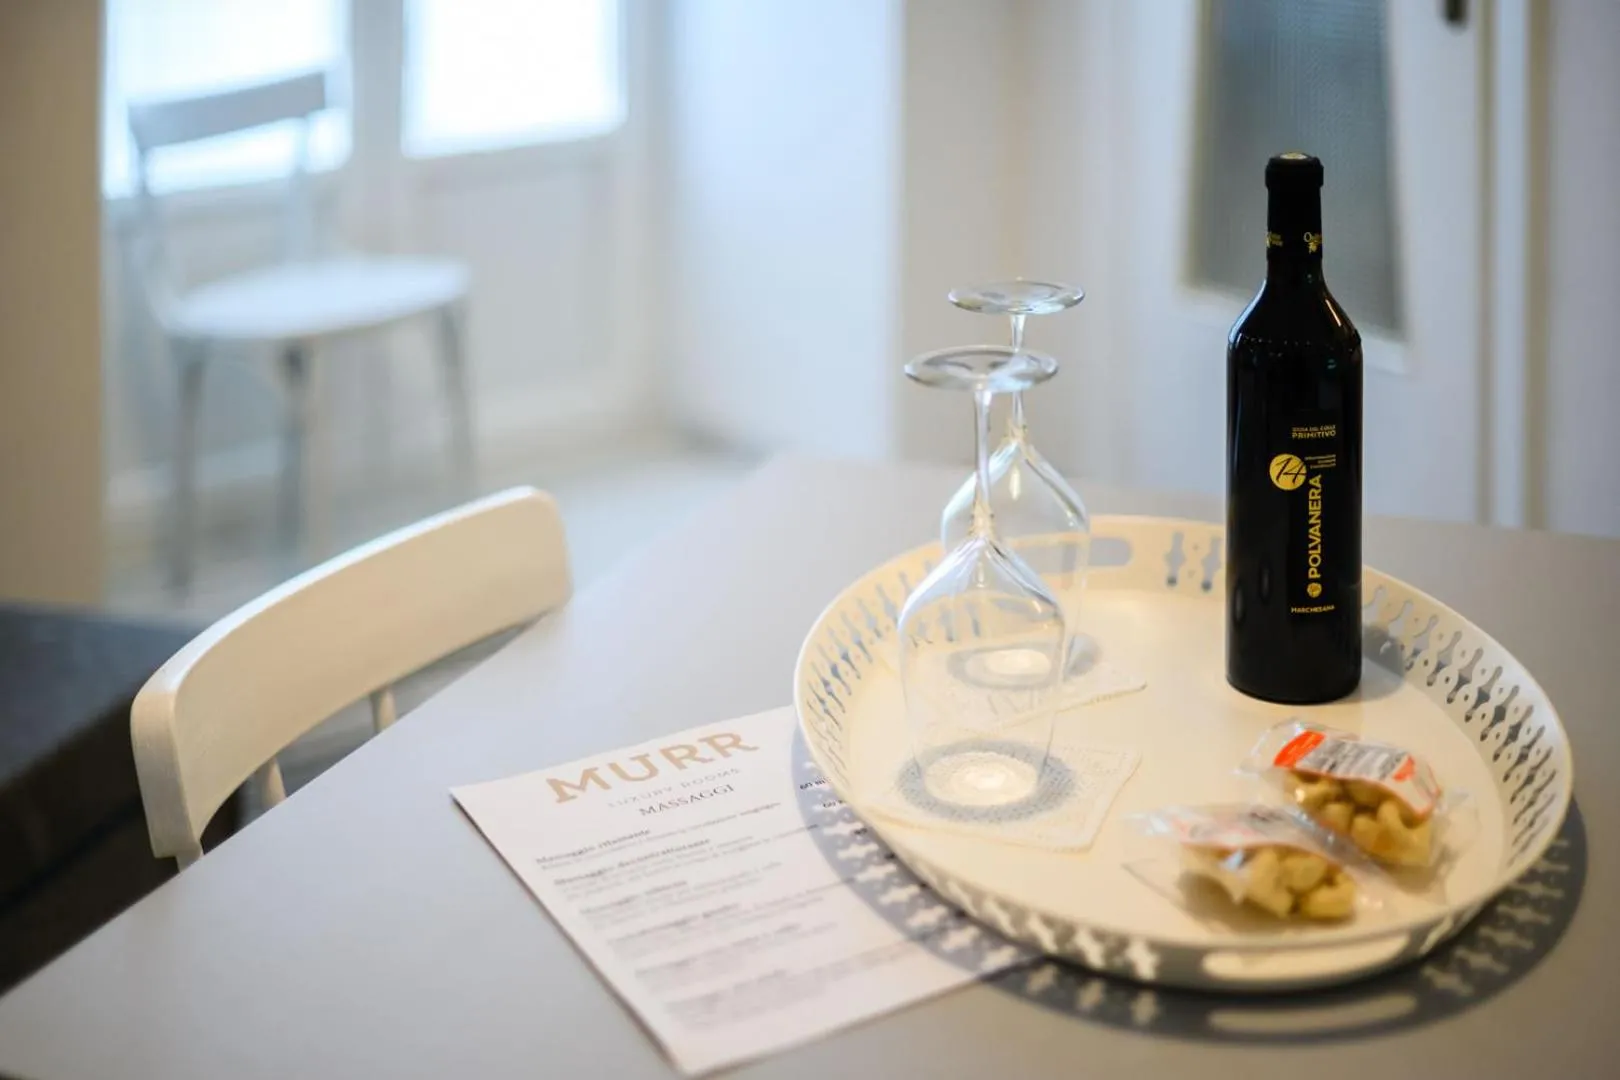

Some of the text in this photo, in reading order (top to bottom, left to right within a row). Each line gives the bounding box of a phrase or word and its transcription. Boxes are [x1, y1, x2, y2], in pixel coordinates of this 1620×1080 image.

[1291, 430, 1336, 439] PRIMITIVO
[1275, 456, 1307, 485] 14
[1308, 474, 1322, 579] POLVANERA
[1290, 603, 1335, 613] MARCHESANA
[545, 732, 760, 804] MURR
[679, 767, 740, 790] ROOMS
[638, 783, 735, 817] MASSAGGI
